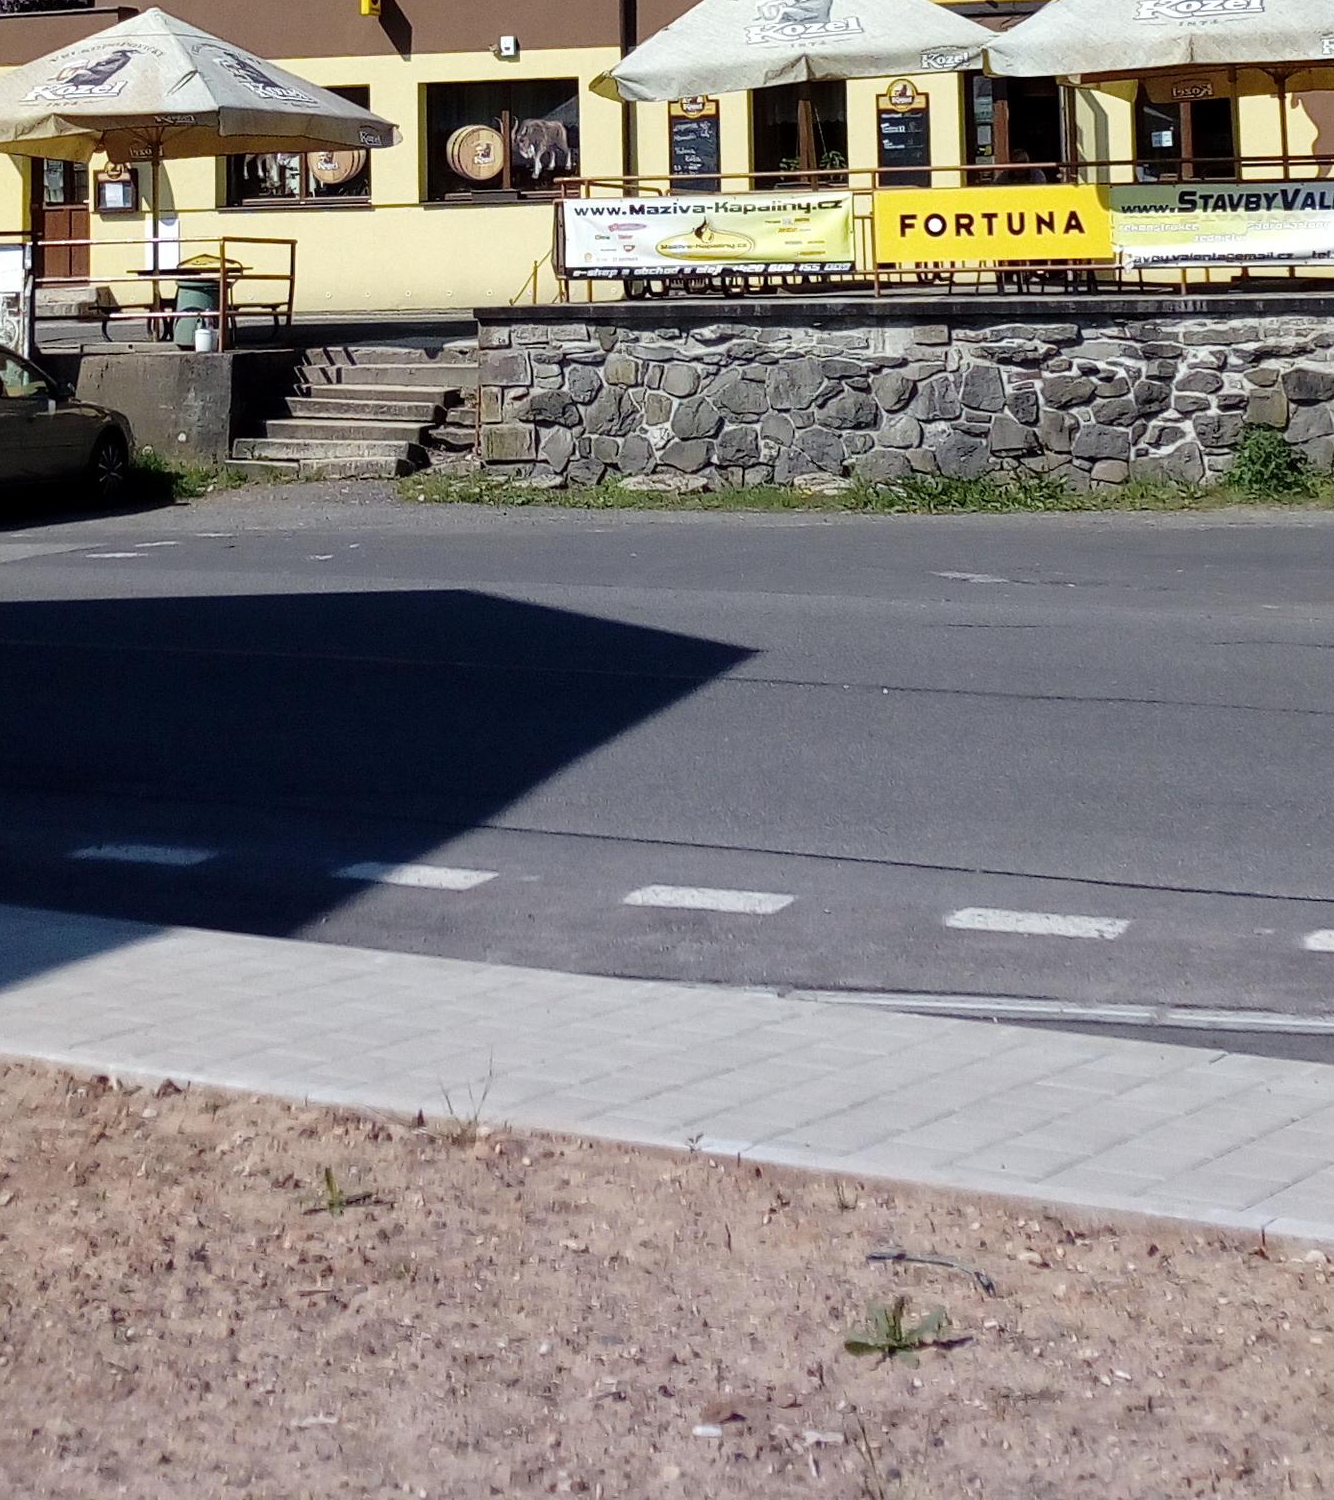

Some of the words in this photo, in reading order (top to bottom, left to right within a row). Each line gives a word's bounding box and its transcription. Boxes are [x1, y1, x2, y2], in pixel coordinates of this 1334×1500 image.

[744, 16, 865, 45] Kozel
[920, 51, 970, 70] Kozel
[19, 80, 129, 102] Kozel
[899, 211, 1085, 237] FORTUNA
[798, 263, 822, 272] 155
